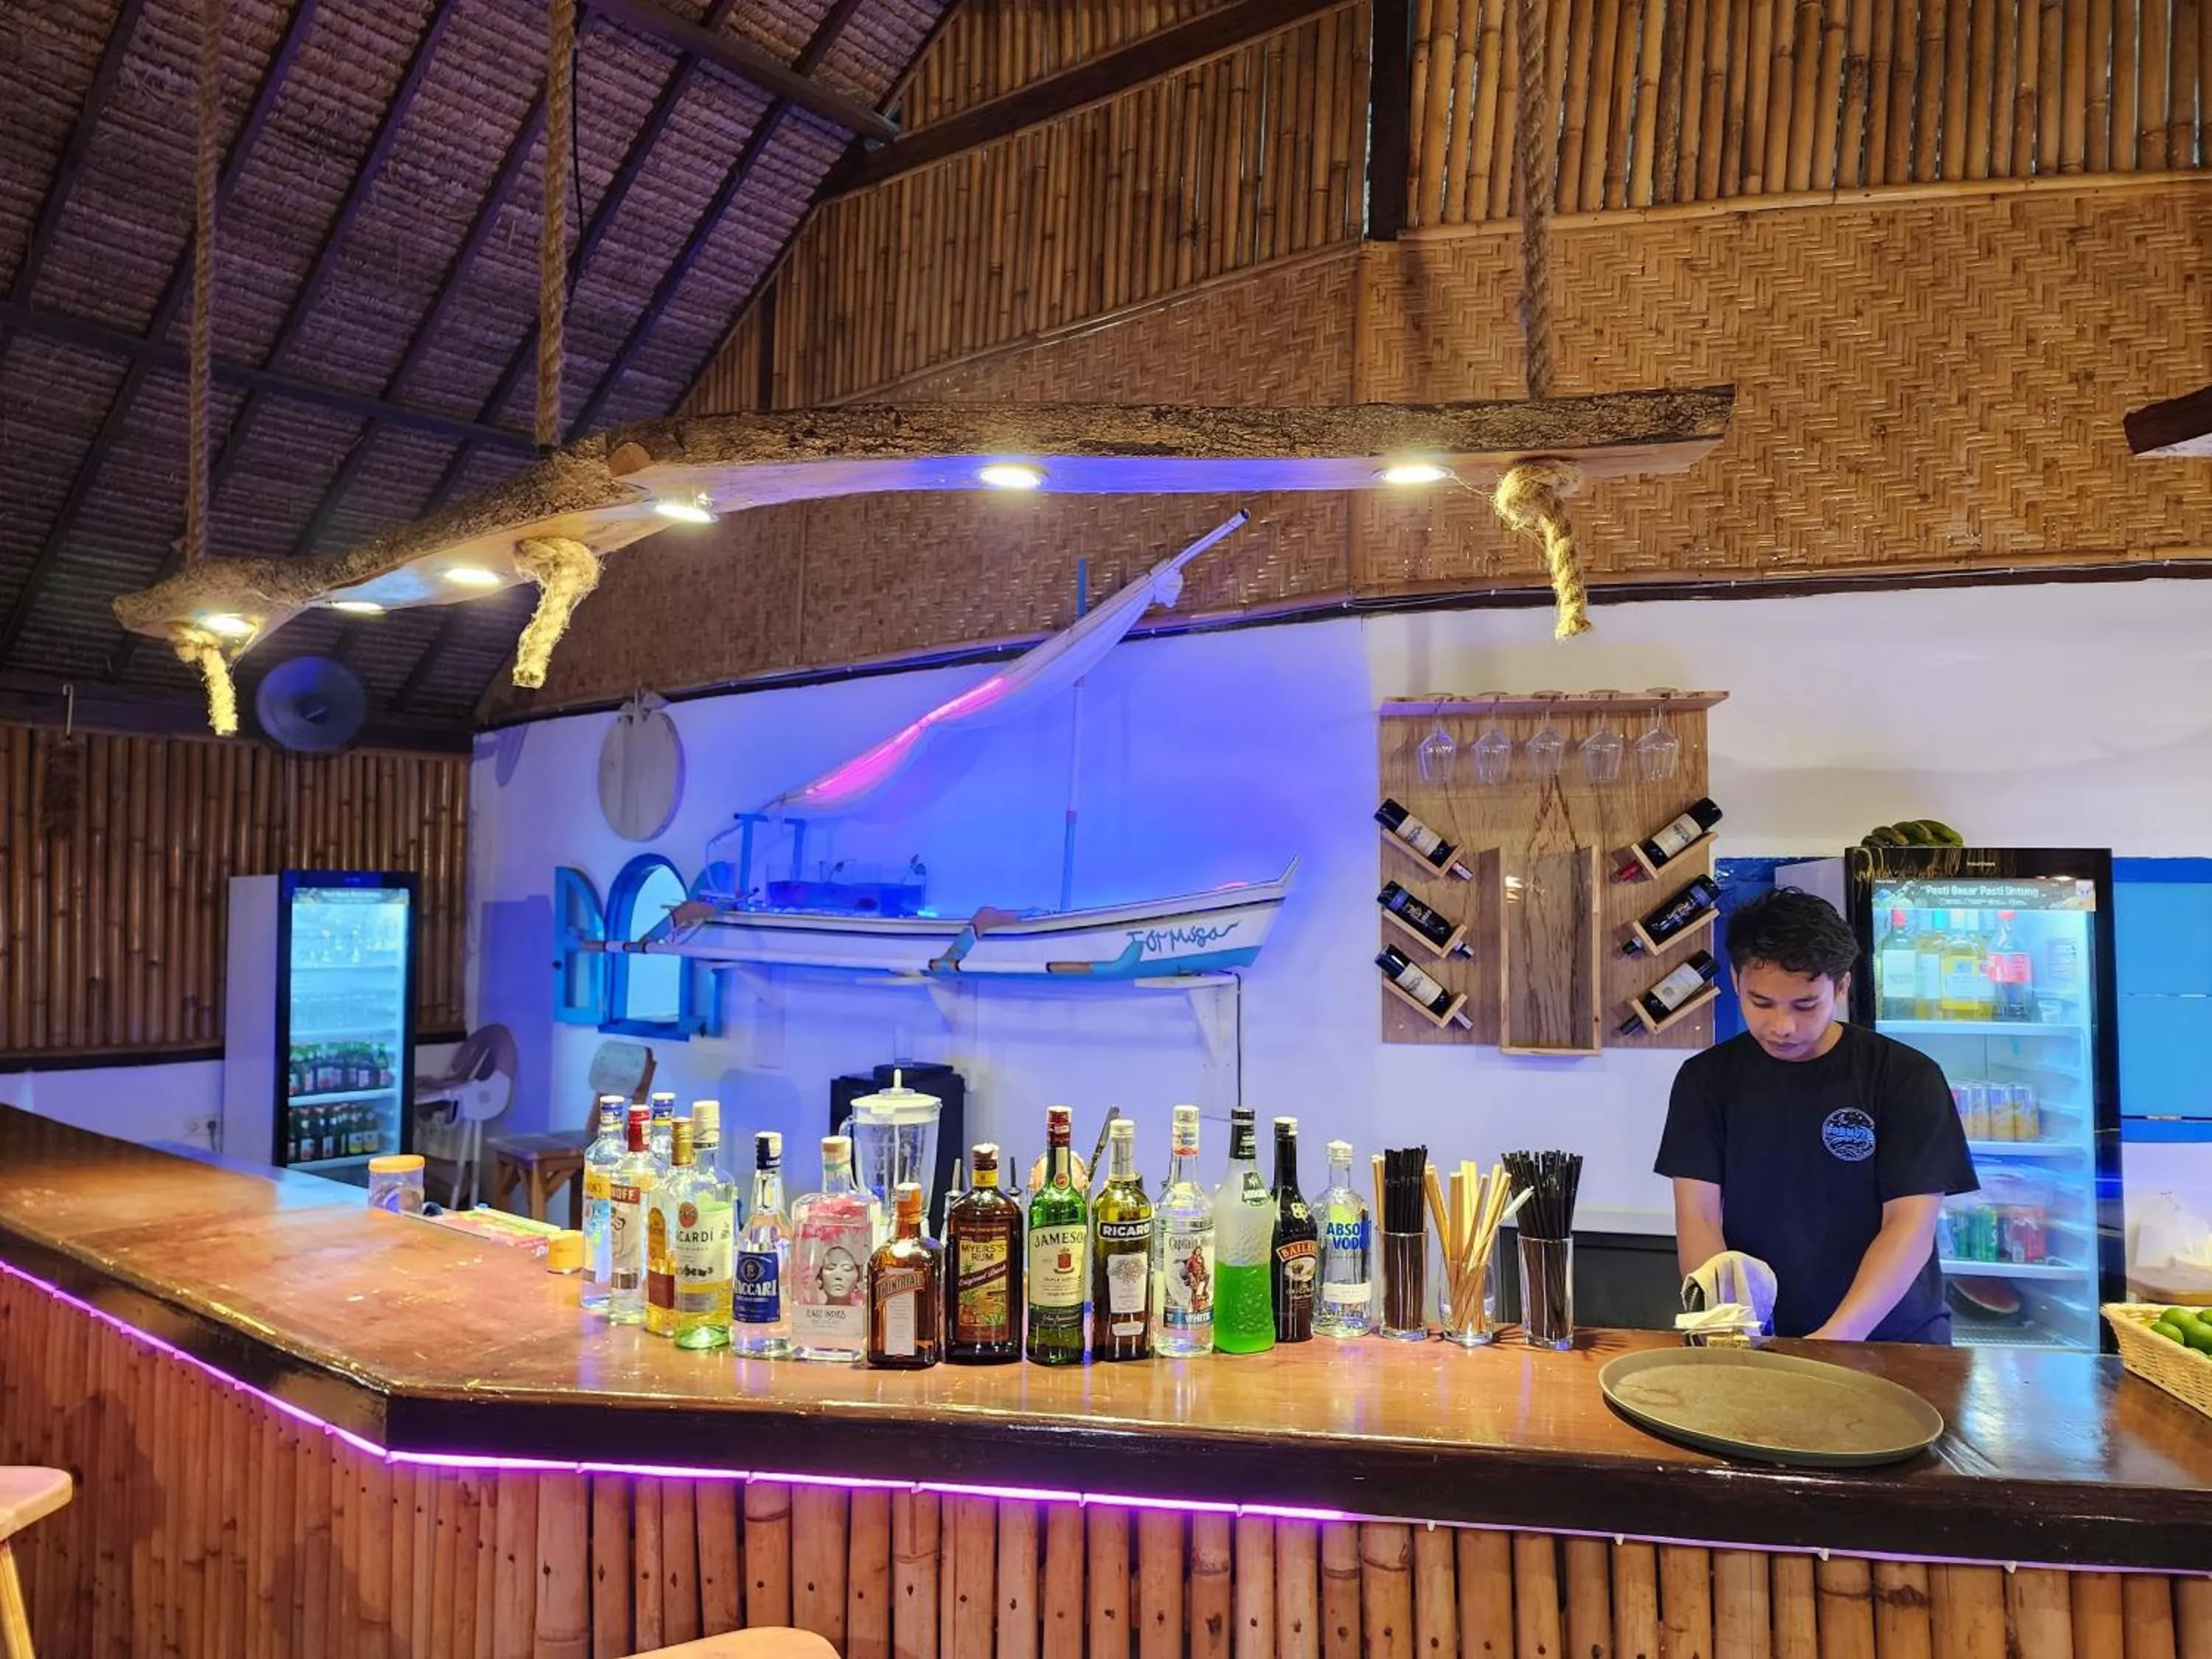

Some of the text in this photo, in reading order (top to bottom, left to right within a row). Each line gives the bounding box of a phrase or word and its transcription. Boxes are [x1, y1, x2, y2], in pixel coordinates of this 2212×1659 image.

[1980, 886, 2004, 896] Pasti
[2006, 886, 2039, 898] Untung
[677, 1226, 714, 1242] CARDÍ
[1102, 1222, 1150, 1237] RICARD
[1326, 1222, 1364, 1237] ABSO
[1034, 1231, 1084, 1248] JAMESO
[1332, 1237, 1366, 1250] VOD
[971, 1253, 994, 1262] RUM
[1280, 1242, 1317, 1258] BAILE
